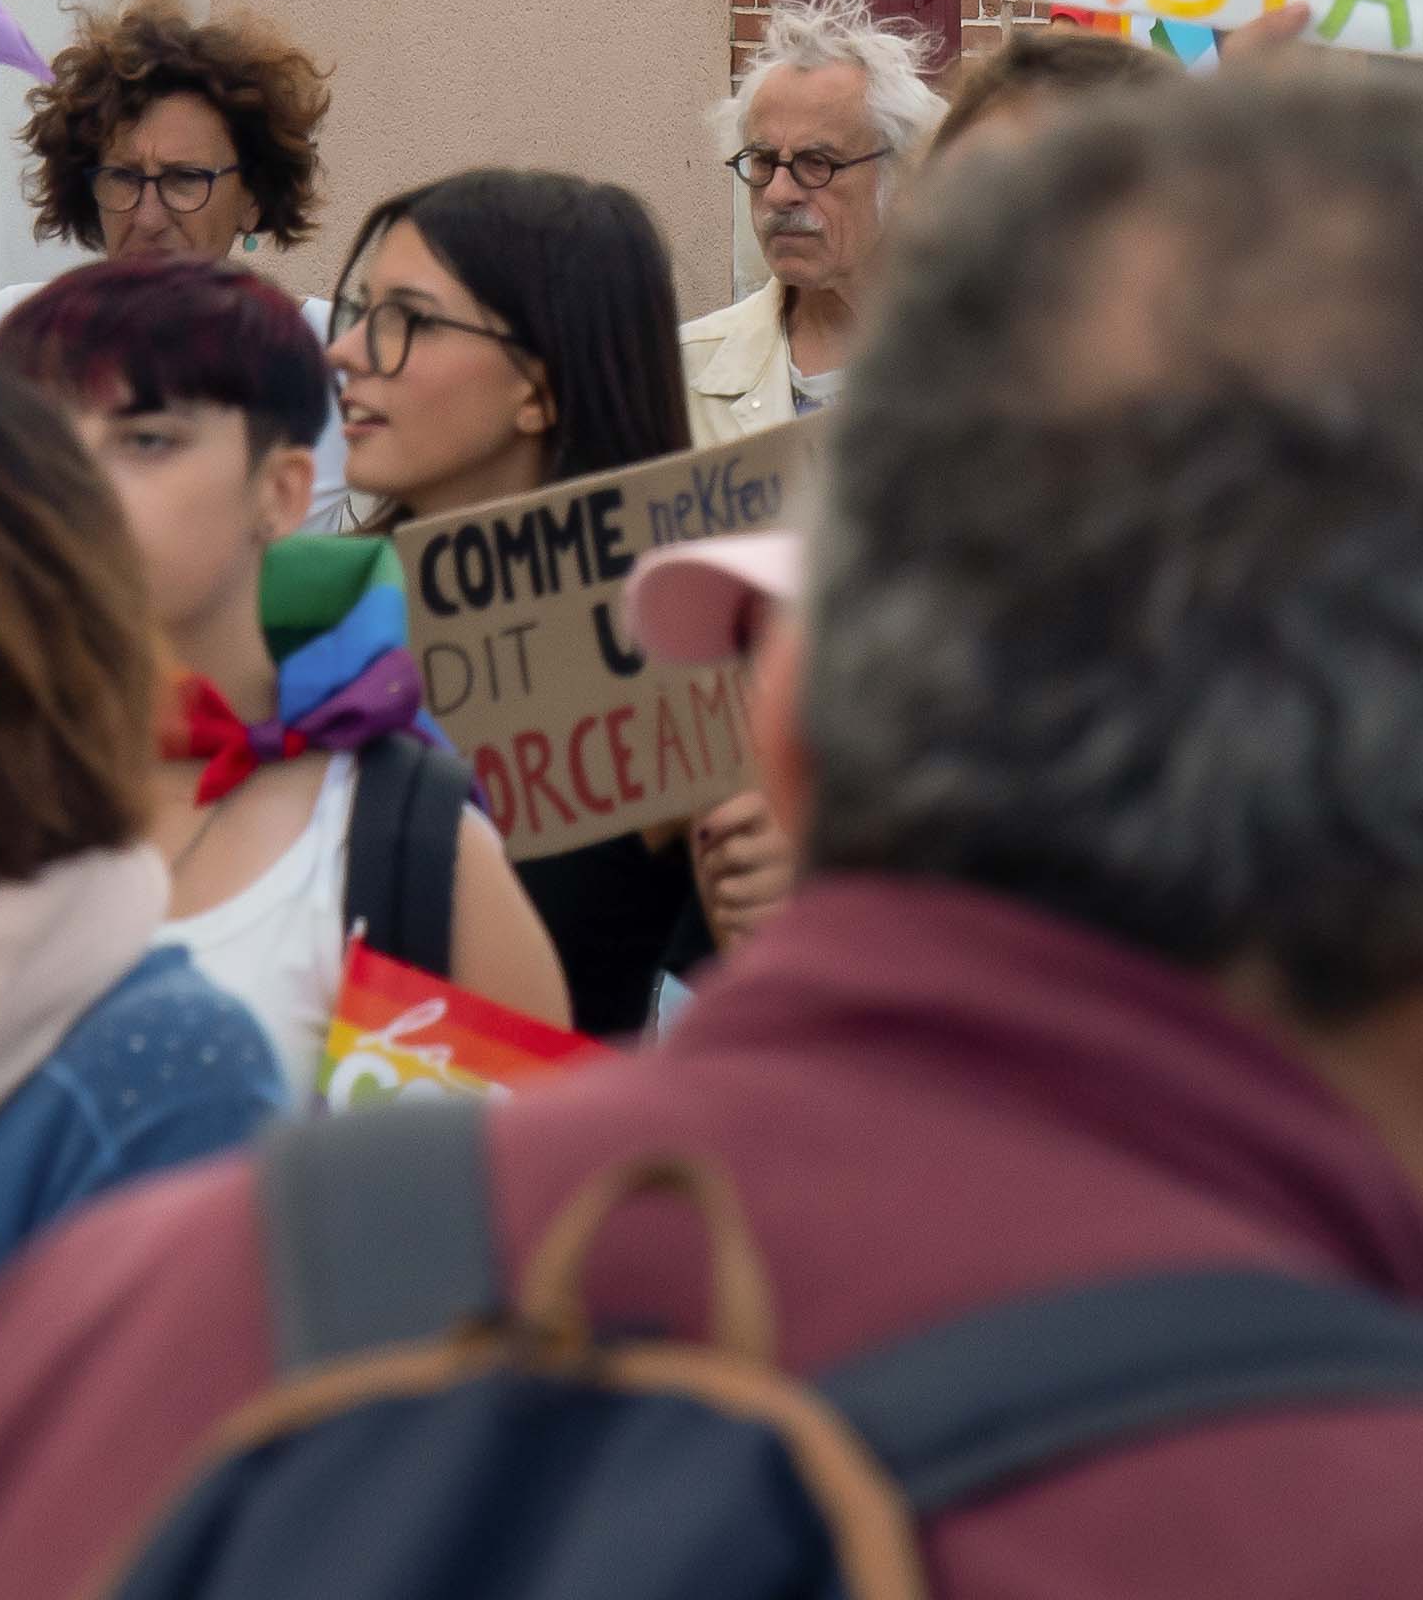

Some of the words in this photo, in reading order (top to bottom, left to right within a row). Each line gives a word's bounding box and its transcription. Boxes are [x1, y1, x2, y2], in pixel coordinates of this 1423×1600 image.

[420, 489, 635, 617] COMME
[422, 622, 538, 718] DIT
[474, 704, 645, 840] ORCE
